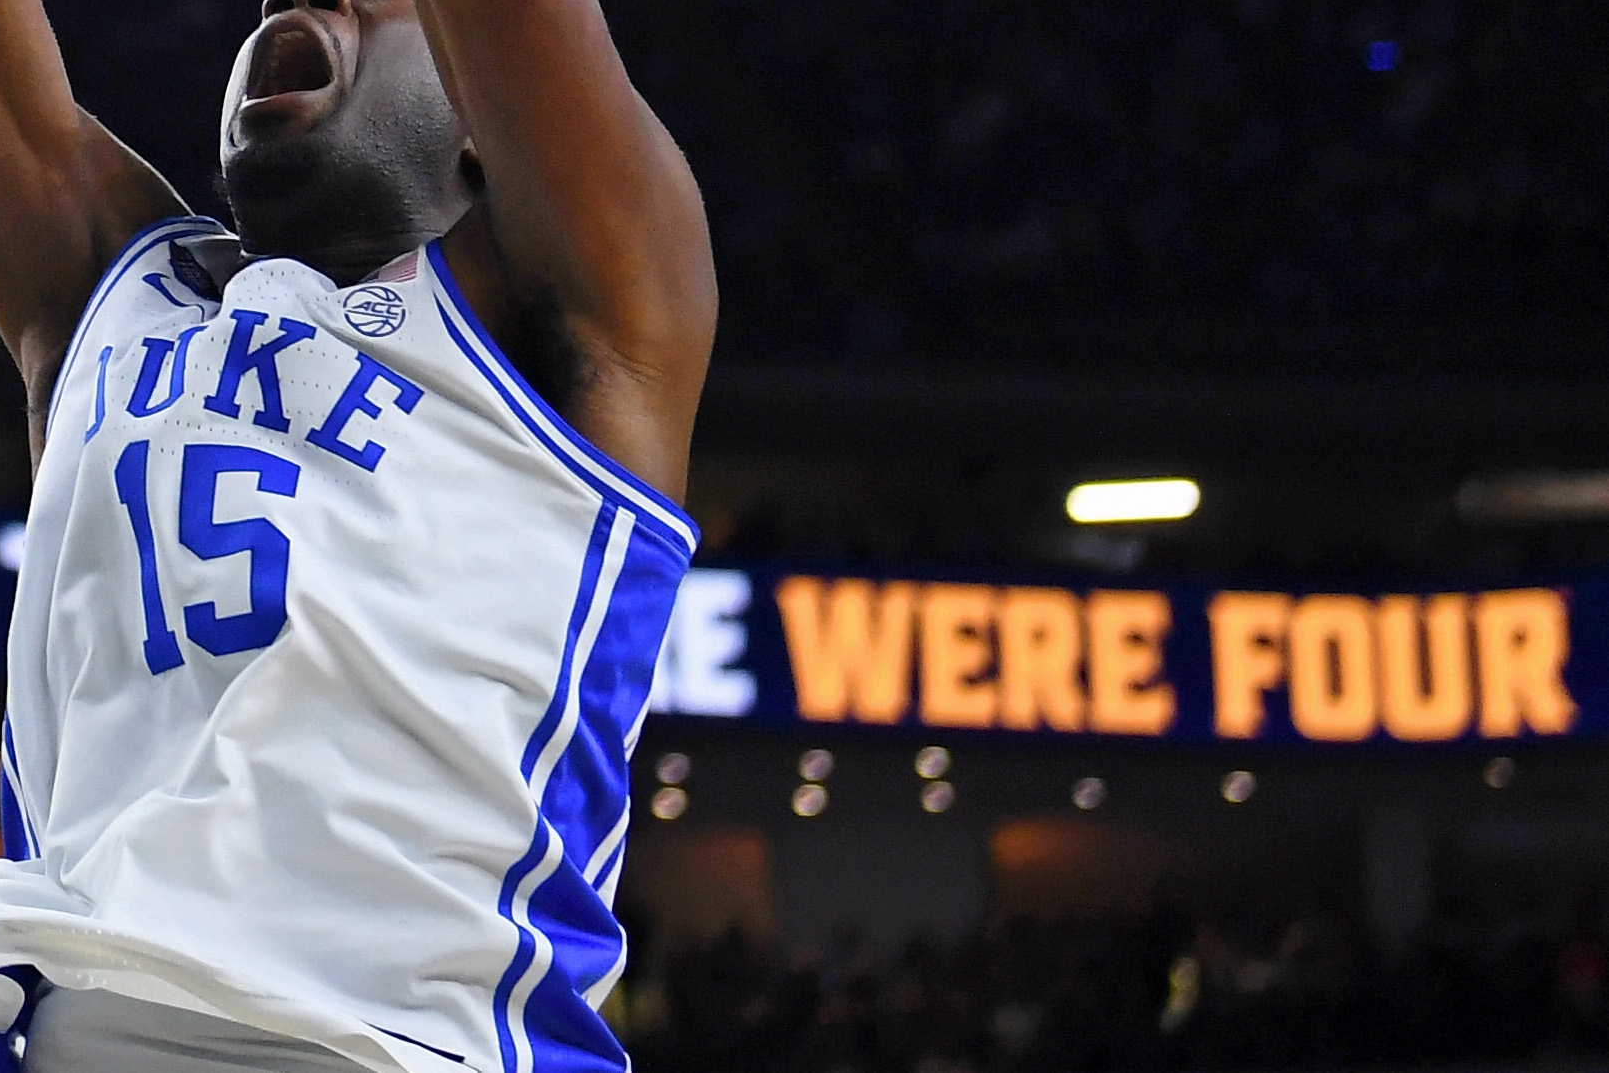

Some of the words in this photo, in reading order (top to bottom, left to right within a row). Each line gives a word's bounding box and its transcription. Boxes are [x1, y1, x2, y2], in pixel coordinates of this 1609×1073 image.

[85, 309, 425, 473] UKE
[115, 439, 301, 676] 15
[778, 575, 1176, 735] WERE
[1208, 588, 1577, 741] FOUR
